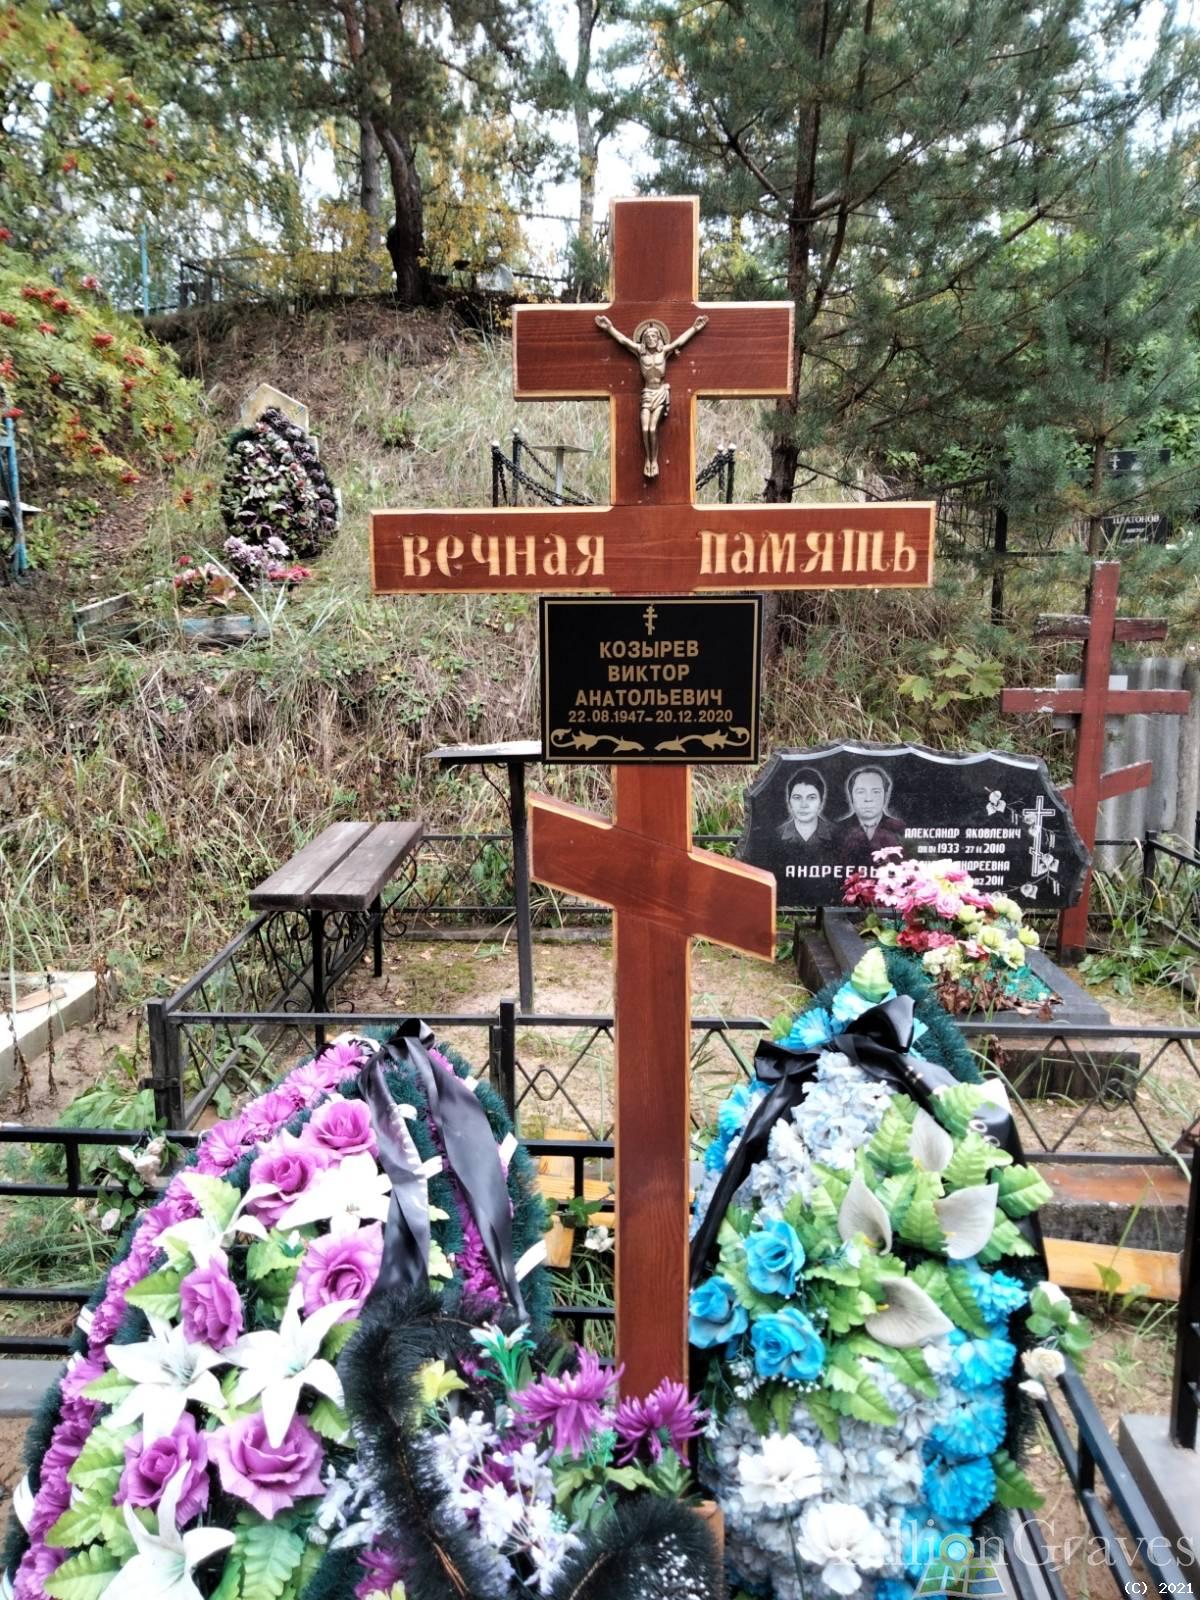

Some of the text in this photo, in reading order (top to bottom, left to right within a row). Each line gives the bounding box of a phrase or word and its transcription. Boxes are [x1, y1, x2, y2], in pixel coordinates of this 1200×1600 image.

[600, 640, 699, 659] КОЗЫРЕВ
[608, 664, 690, 682] ВИКТОР
[575, 689, 723, 707] АНАТОЛЬЕВИЧ
[904, 828, 1022, 839] АЛЕКСАНДР ЯКОВЛЕВИЧ
[956, 860, 1011, 871] НДРЕЕВНА
